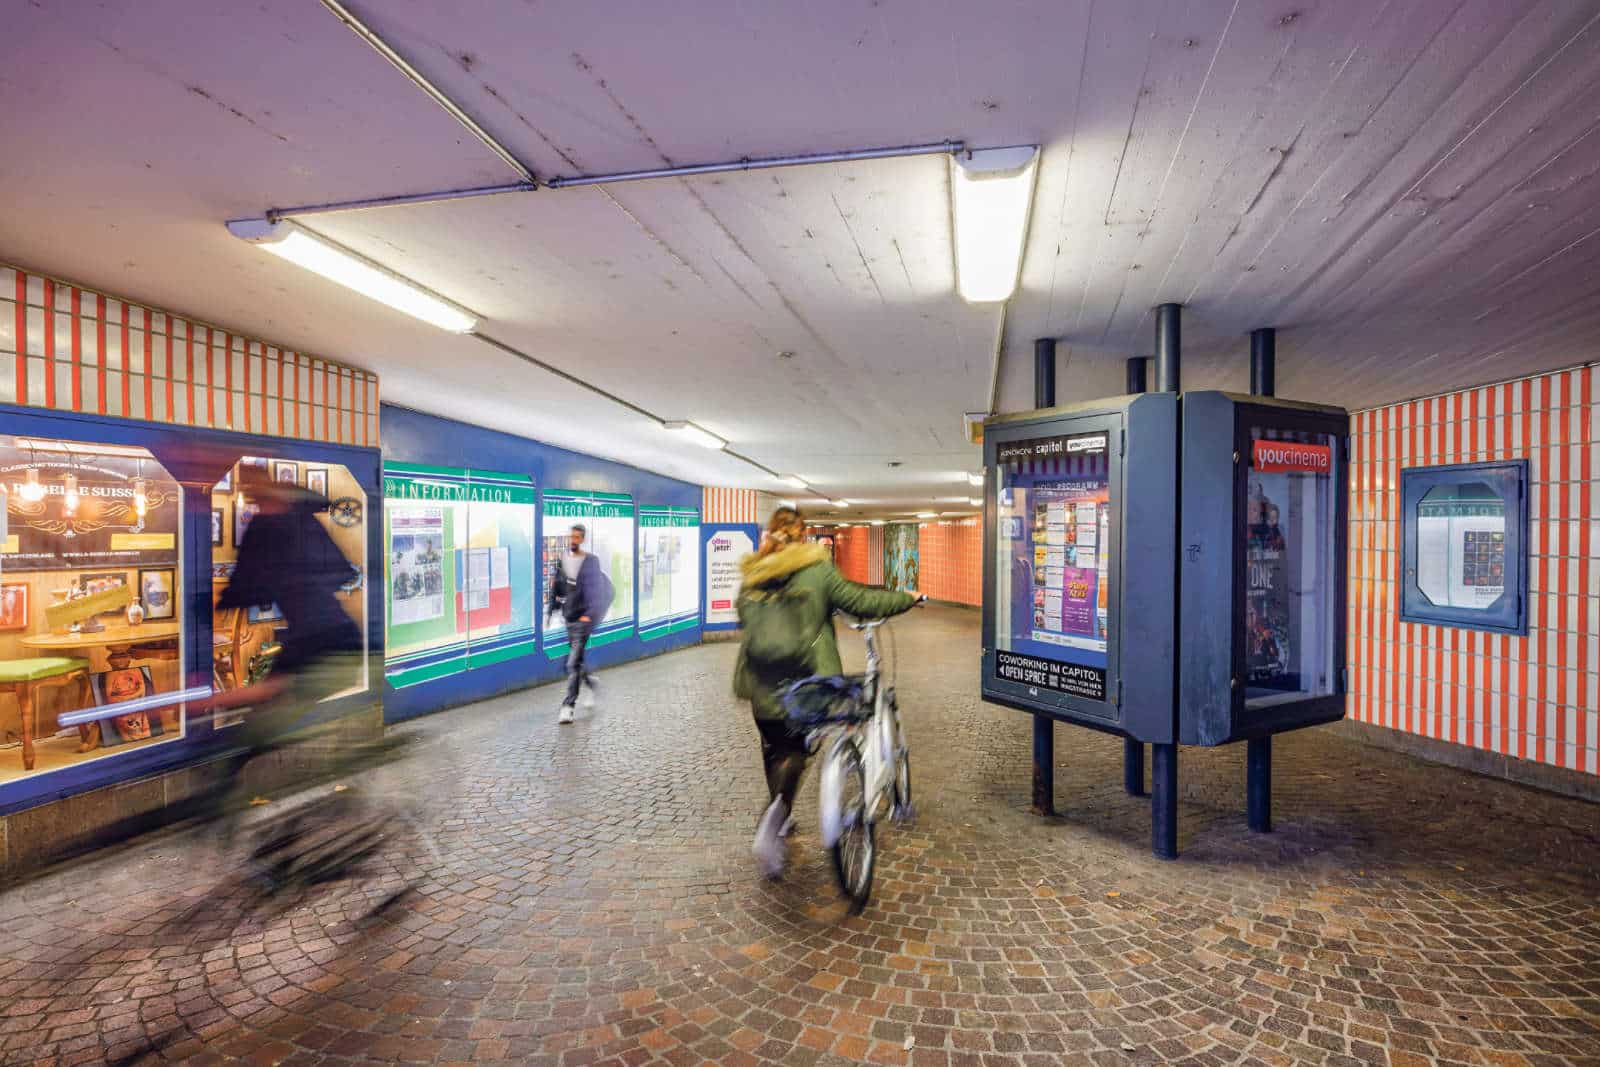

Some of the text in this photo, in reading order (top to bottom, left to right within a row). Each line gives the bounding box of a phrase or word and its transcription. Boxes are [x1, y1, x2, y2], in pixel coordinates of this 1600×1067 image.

[1036, 441, 1062, 456] capitol
[1258, 448, 1327, 469] youcinema
[92, 487, 138, 497] SUISS
[401, 483, 511, 503] INFORMATION
[552, 504, 620, 517] INFORMATION
[644, 515, 689, 527] INFORMATION
[999, 654, 1102, 682] COWORKING IM CAPITOL
[1005, 667, 1023, 680] OPEN
[1024, 669, 1047, 685] SPACE
